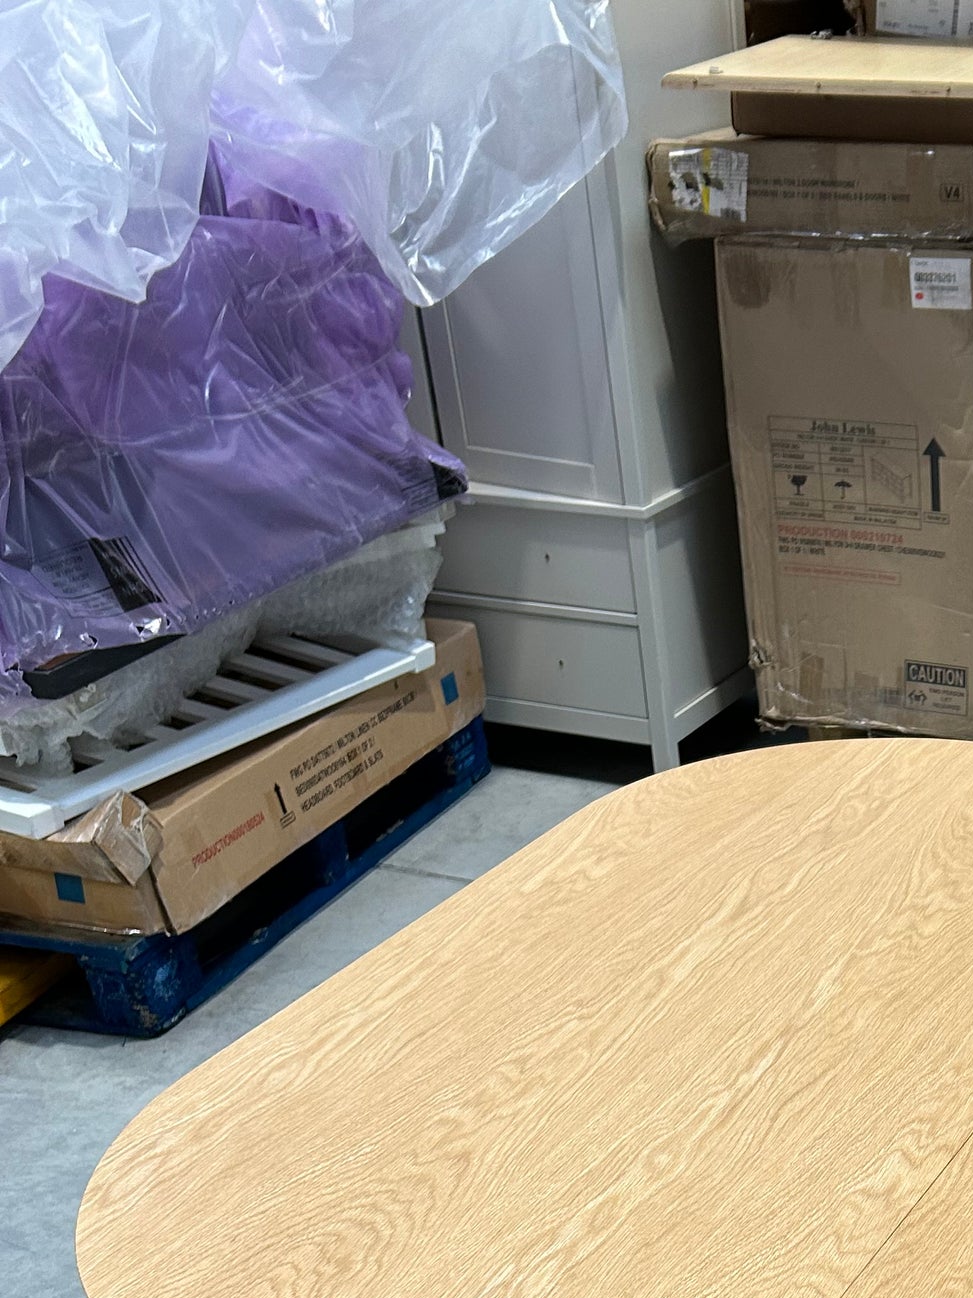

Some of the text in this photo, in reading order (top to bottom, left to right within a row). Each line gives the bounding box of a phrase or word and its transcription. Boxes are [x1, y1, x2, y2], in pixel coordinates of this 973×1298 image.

[943, 184, 960, 199] V4
[777, 524, 848, 538] PRODUCTION
[909, 664, 964, 687] CAUTION
